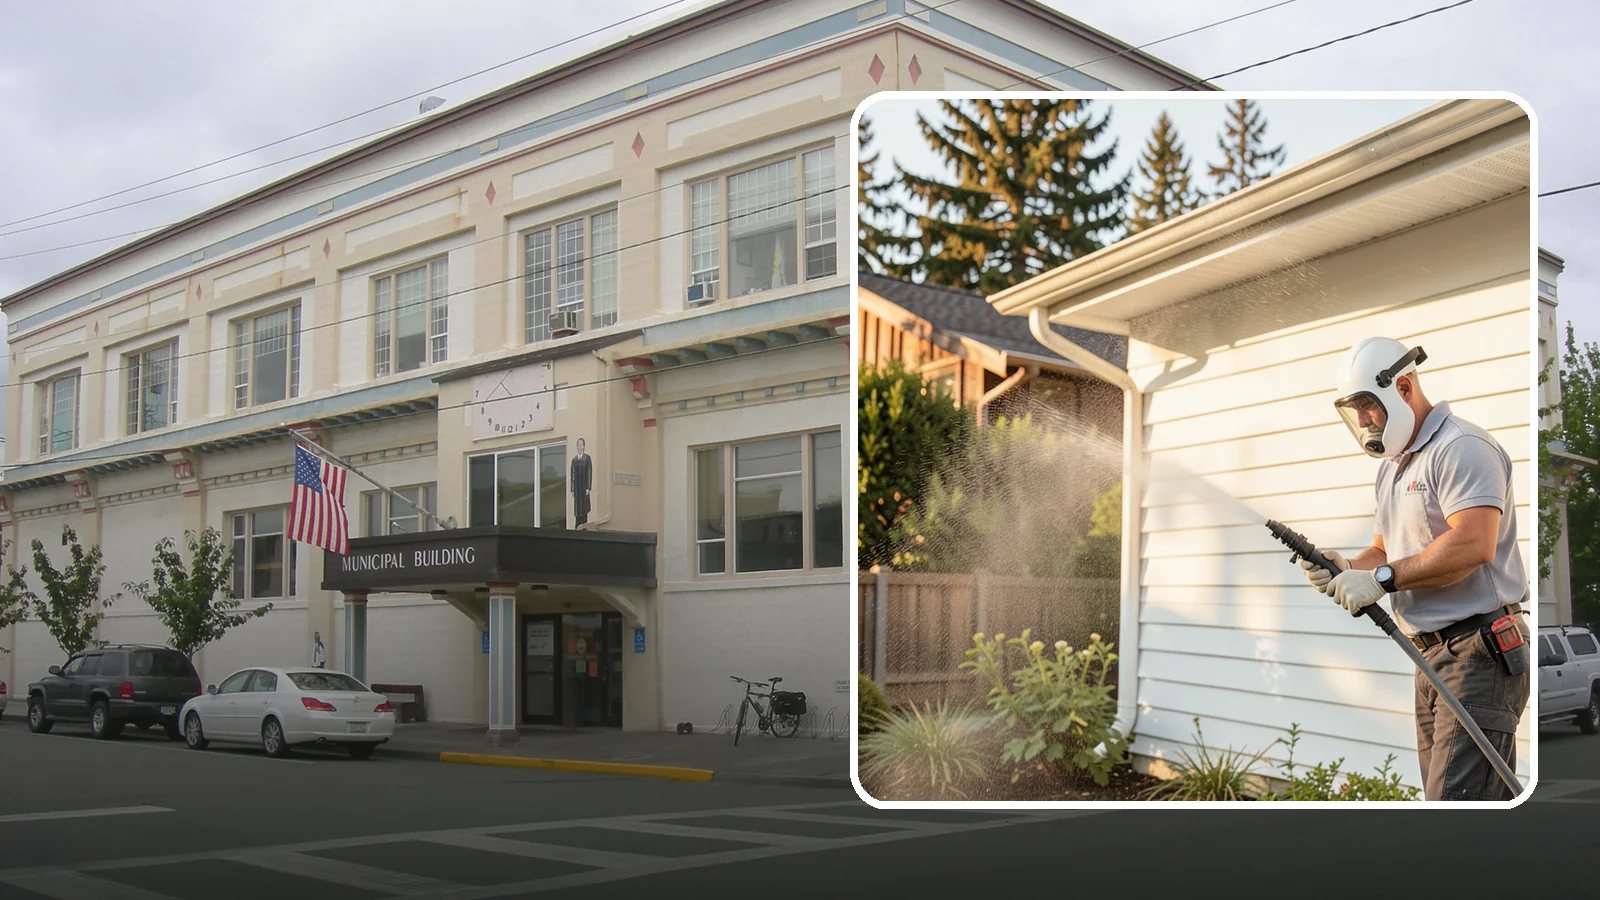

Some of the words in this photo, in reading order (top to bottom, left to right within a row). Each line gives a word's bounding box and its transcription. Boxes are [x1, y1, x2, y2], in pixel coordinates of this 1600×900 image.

[476, 390, 479, 398] 7
[536, 402, 540, 410] 4
[481, 406, 484, 415] 8
[488, 418, 492, 426] 9
[529, 414, 533, 422] 3
[494, 424, 500, 432] 10
[521, 420, 525, 428] 2
[508, 425, 513, 433] 12
[342, 552, 405, 572] MUNICIPAL
[414, 546, 475, 567] BUILDING
